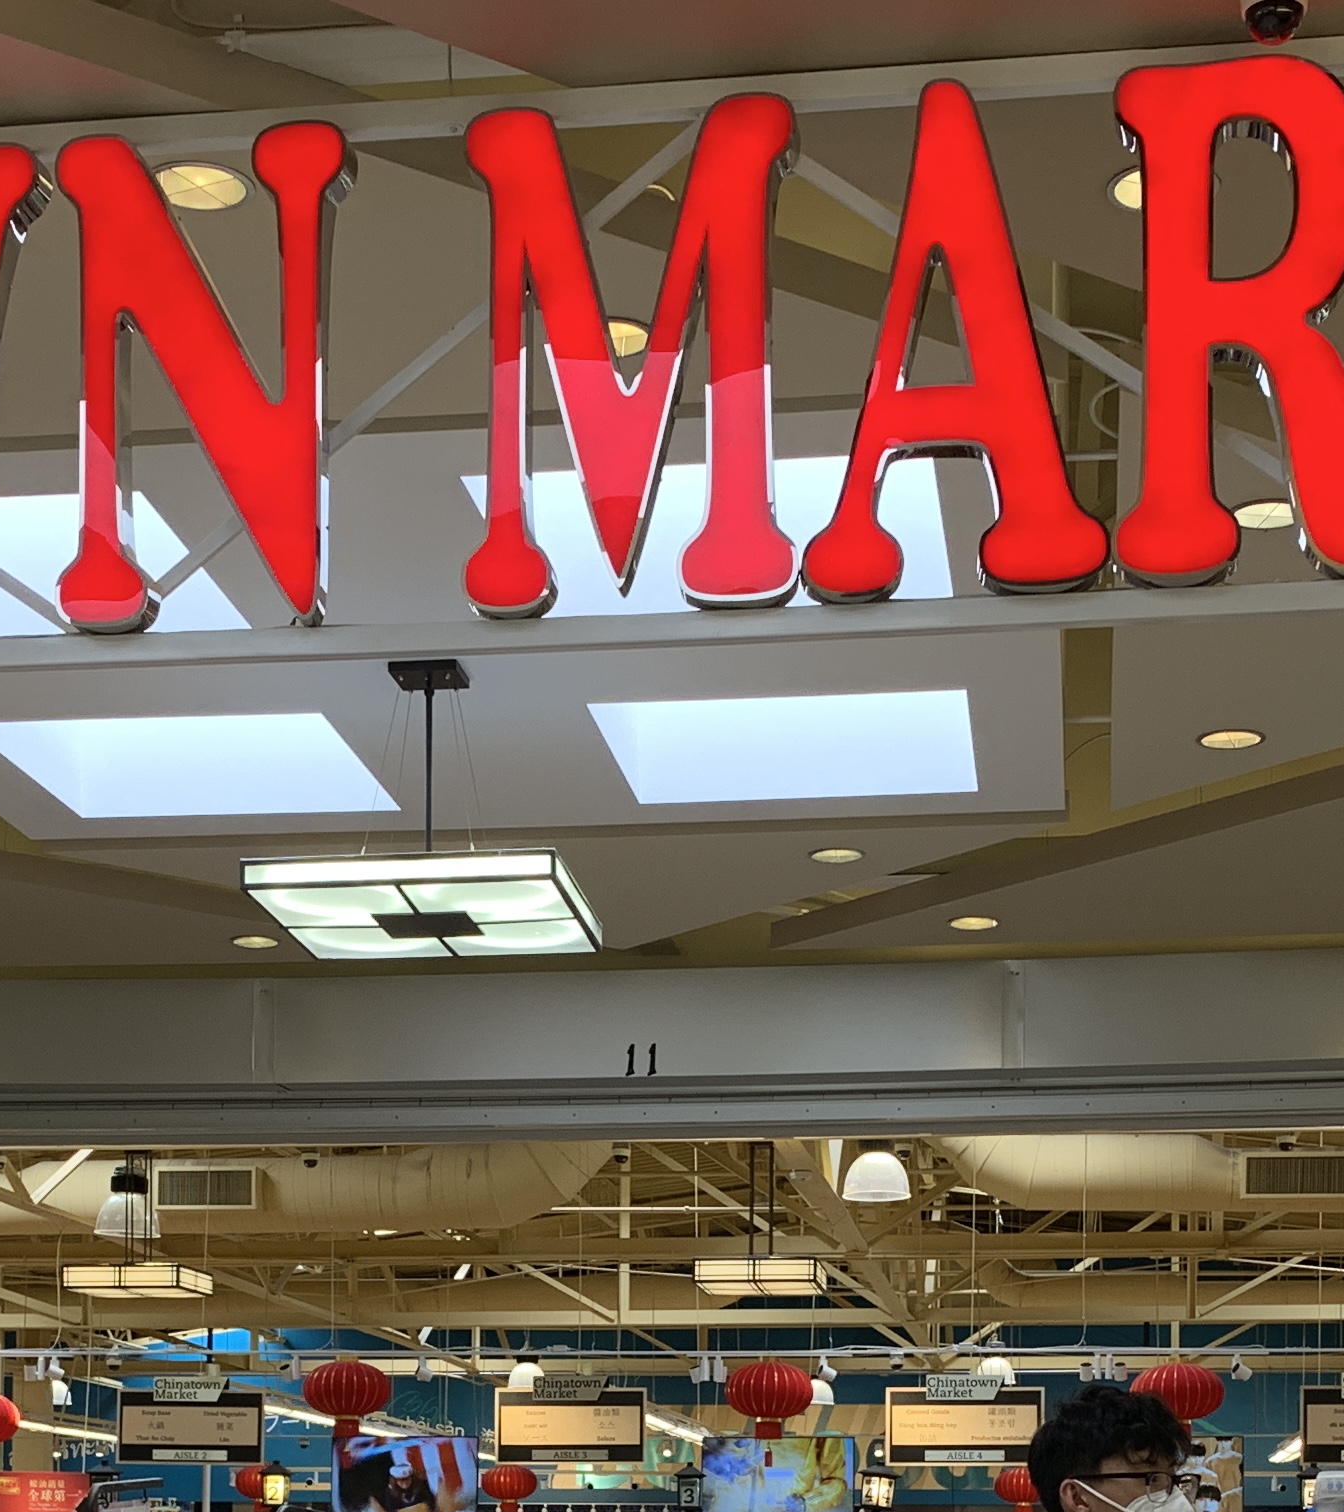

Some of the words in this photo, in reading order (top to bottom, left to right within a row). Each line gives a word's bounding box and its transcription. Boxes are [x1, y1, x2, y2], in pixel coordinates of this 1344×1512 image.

[624, 1042, 657, 1077] 11
[154, 1378, 221, 1390] Chinatown
[533, 1377, 603, 1390] Chinatown
[927, 1376, 998, 1388] Chinatown
[154, 1389, 198, 1400] Market
[533, 1388, 578, 1399] Market
[927, 1387, 973, 1398] Market
[173, 1451, 199, 1460] AISLE
[201, 1451, 208, 1459] 2
[553, 1451, 580, 1459] AISLE
[946, 1452, 974, 1460] AISLE
[976, 1452, 983, 1460] 4
[268, 1486, 278, 1501] 2
[682, 1487, 695, 1504] 3
[865, 1488, 873, 1502] 4
[881, 1489, 890, 1504] 4
